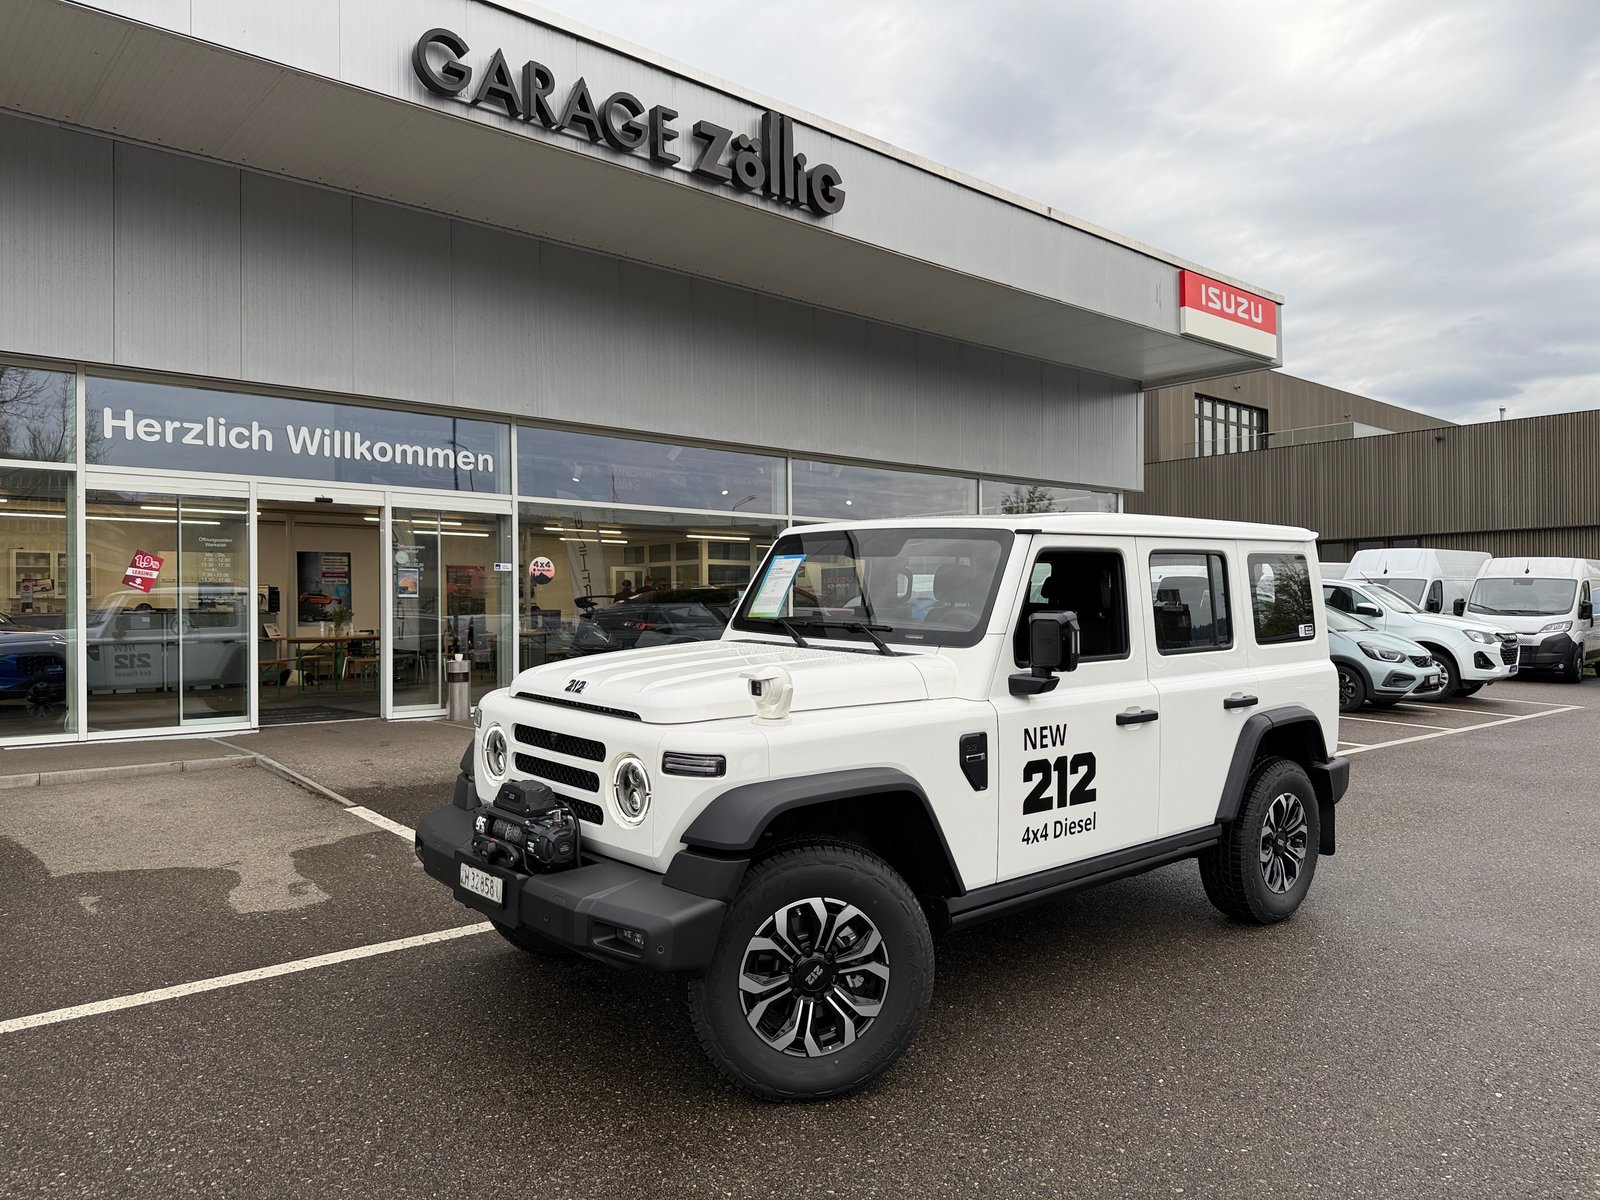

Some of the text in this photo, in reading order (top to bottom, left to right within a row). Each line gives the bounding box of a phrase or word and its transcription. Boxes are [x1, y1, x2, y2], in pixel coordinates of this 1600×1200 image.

[412, 27, 680, 166] GARAGE
[1201, 283, 1263, 324] ISUZU
[102, 406, 273, 452] Herzlich
[285, 424, 494, 473] Willkommen
[131, 569, 153, 577] LEASING
[533, 560, 551, 568] 4x4
[564, 678, 587, 694] 212
[1023, 723, 1067, 752] NEW
[1022, 751, 1097, 816] 212
[1021, 811, 1097, 846] 4x4 Diesel
[804, 965, 824, 985] 212
